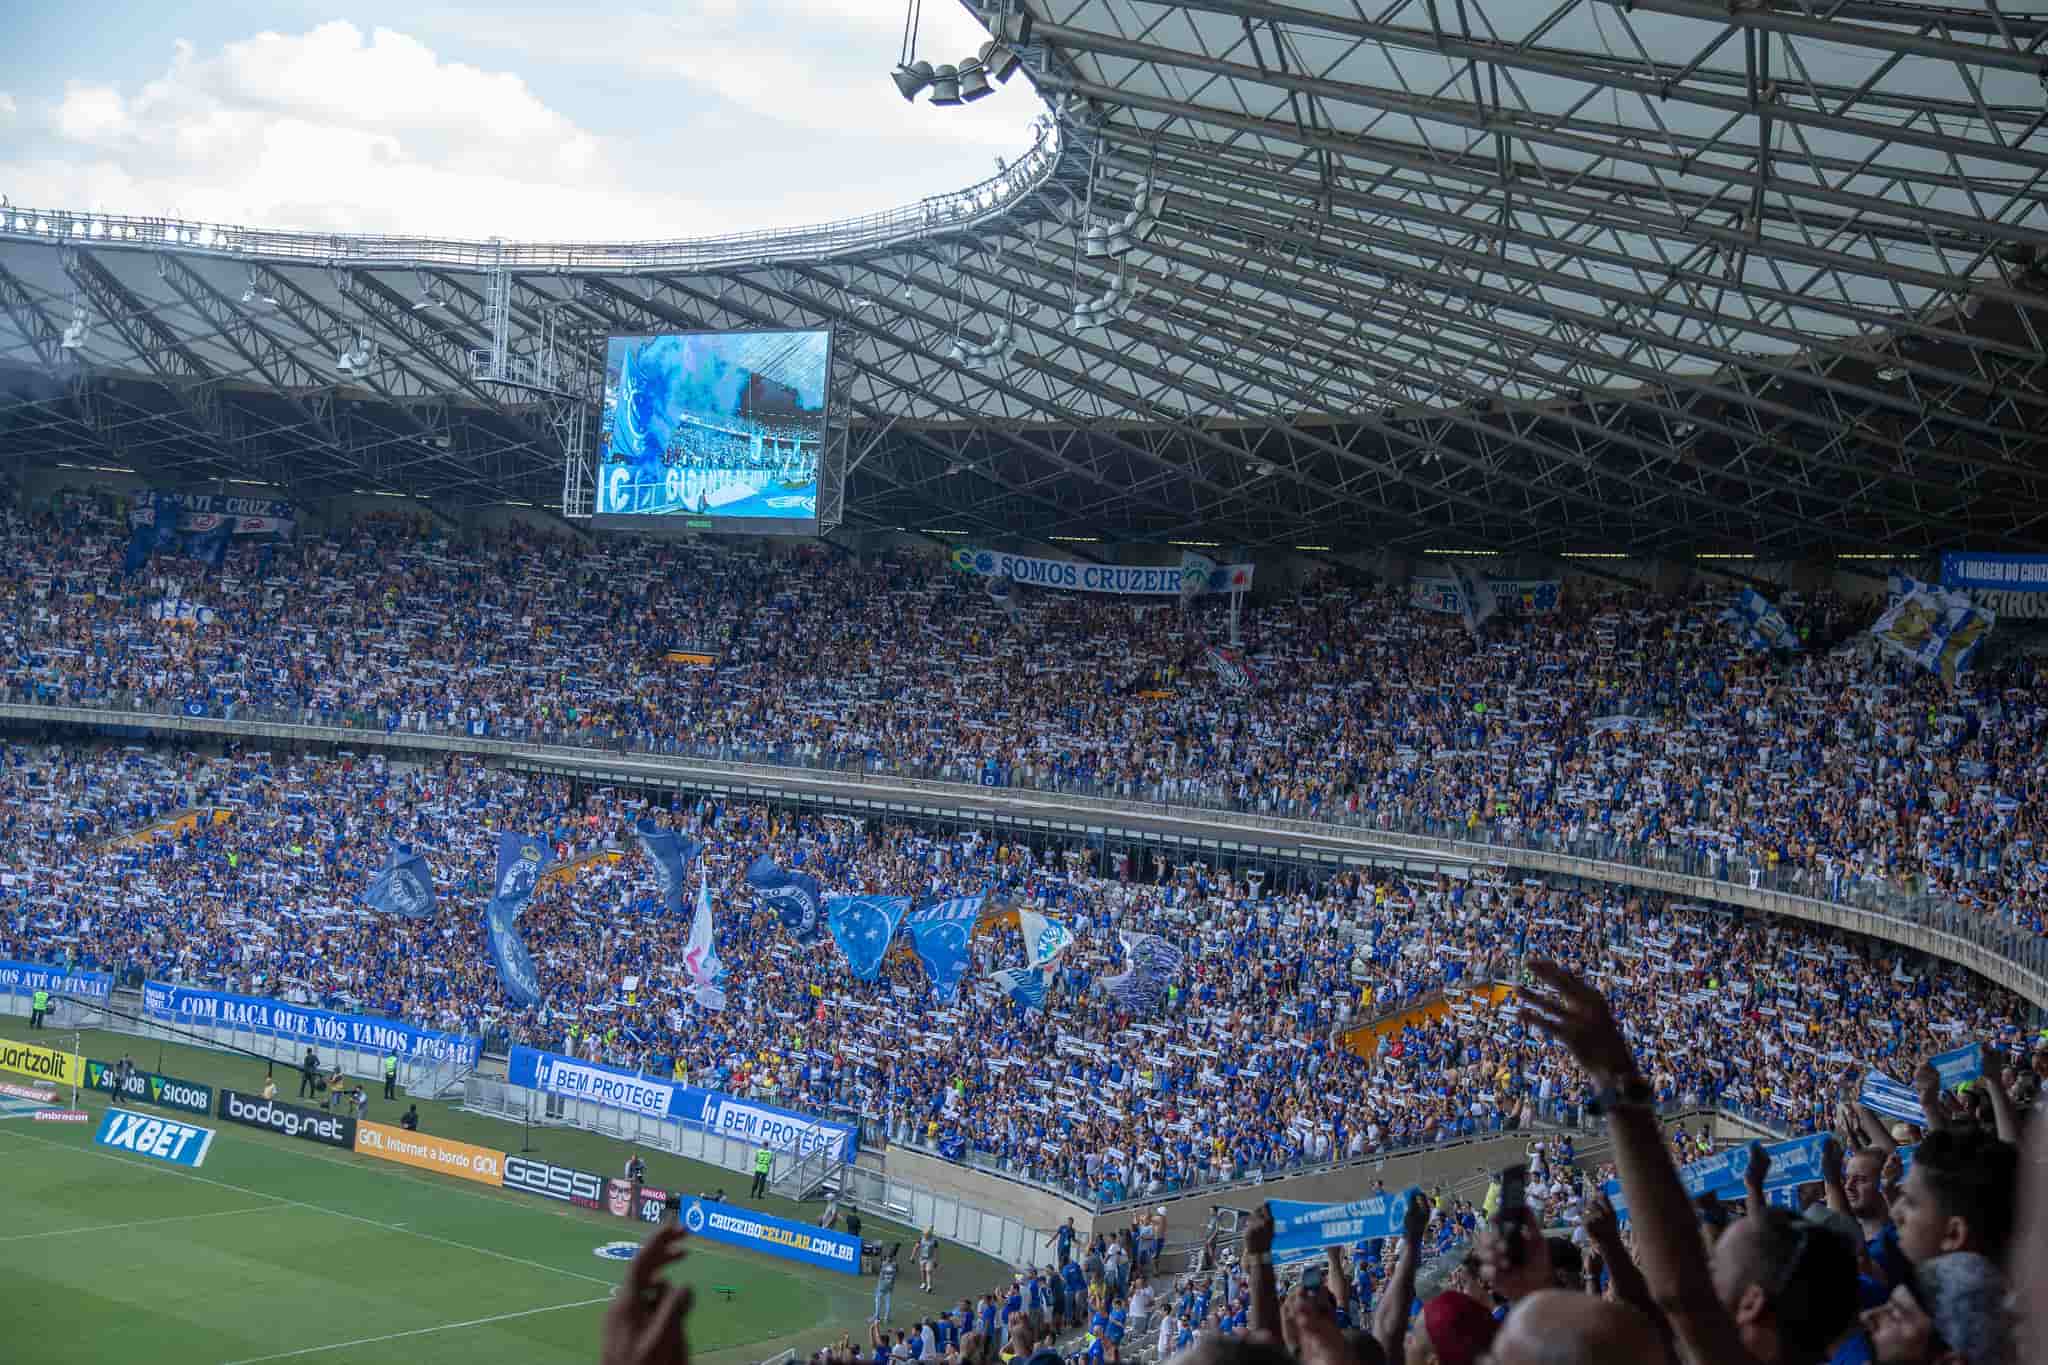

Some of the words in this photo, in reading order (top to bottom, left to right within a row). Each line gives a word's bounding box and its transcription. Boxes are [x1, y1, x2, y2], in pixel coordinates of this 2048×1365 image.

[1001, 555, 1077, 586] SOMOS
[1084, 567, 1185, 593] CRUZEIR
[23, 971, 48, 989] ATÉ
[52, 975, 61, 990] O
[182, 996, 217, 1017] COM
[224, 1000, 267, 1025] RAÇA
[274, 1009, 309, 1033] QUE
[313, 1016, 346, 1040] NÓS
[353, 1022, 407, 1051] VAMOS
[162, 1085, 208, 1109] SICOOB
[556, 1068, 589, 1090] BEM
[592, 1077, 665, 1110] PROTEGE
[103, 1113, 197, 1161] 1XBET
[229, 1092, 343, 1140] bodog.net
[723, 1110, 757, 1135] BEM
[359, 1127, 384, 1149] GOL
[386, 1135, 428, 1158] Internet
[429, 1149, 436, 1160] a
[438, 1149, 469, 1168] bordo
[472, 1154, 498, 1177] GOL
[708, 1212, 854, 1262] CRUZEIROCELULAR.COM.BR
